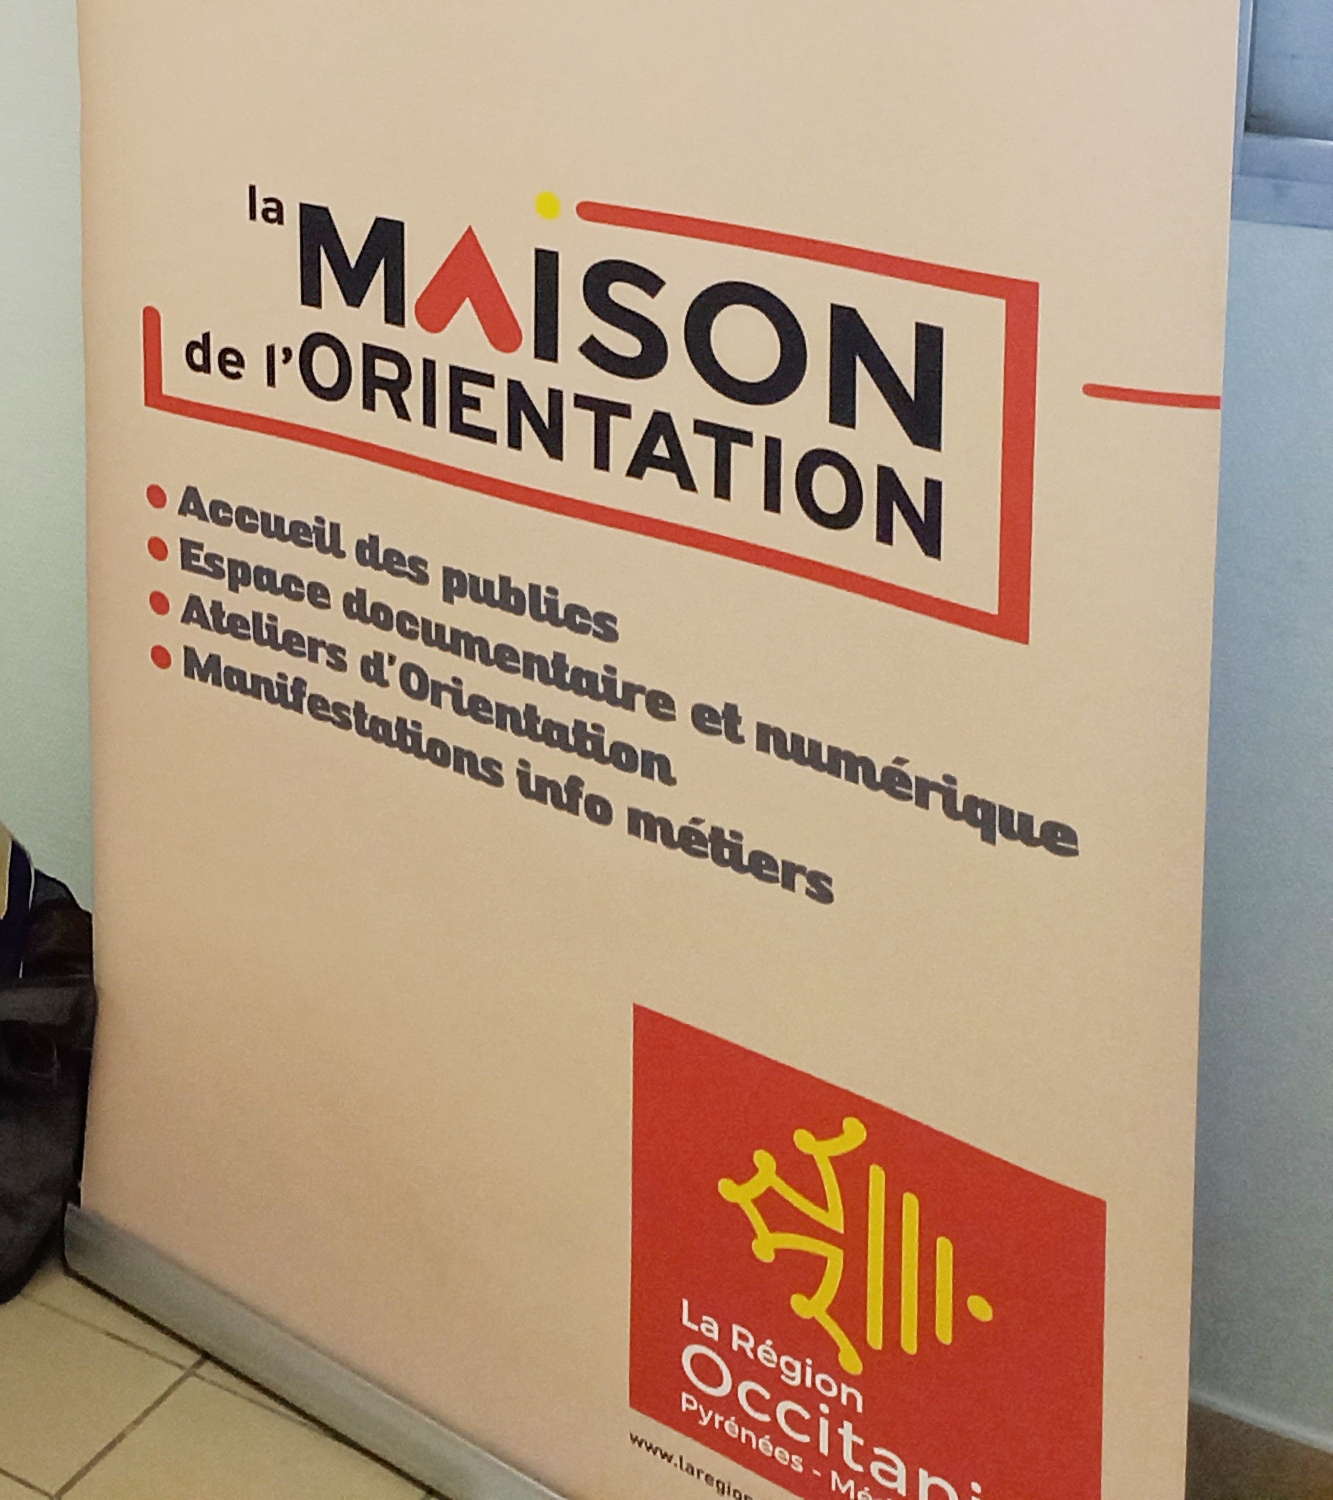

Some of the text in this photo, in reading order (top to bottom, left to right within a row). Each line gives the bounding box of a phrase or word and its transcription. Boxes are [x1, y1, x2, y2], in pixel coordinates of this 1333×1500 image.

[247, 183, 945, 452] la MAISON
[185, 331, 943, 561] de l'ORIENTATION
[177, 485, 620, 643] Accueil des publics
[179, 536, 1079, 858] Espace documentaire et numérique
[180, 593, 677, 787] Ateliers d'Orientation
[183, 644, 835, 905] Manifestations info métiers
[681, 1298, 864, 1414] La Région
[681, 1391, 804, 1473] Pyrénées
